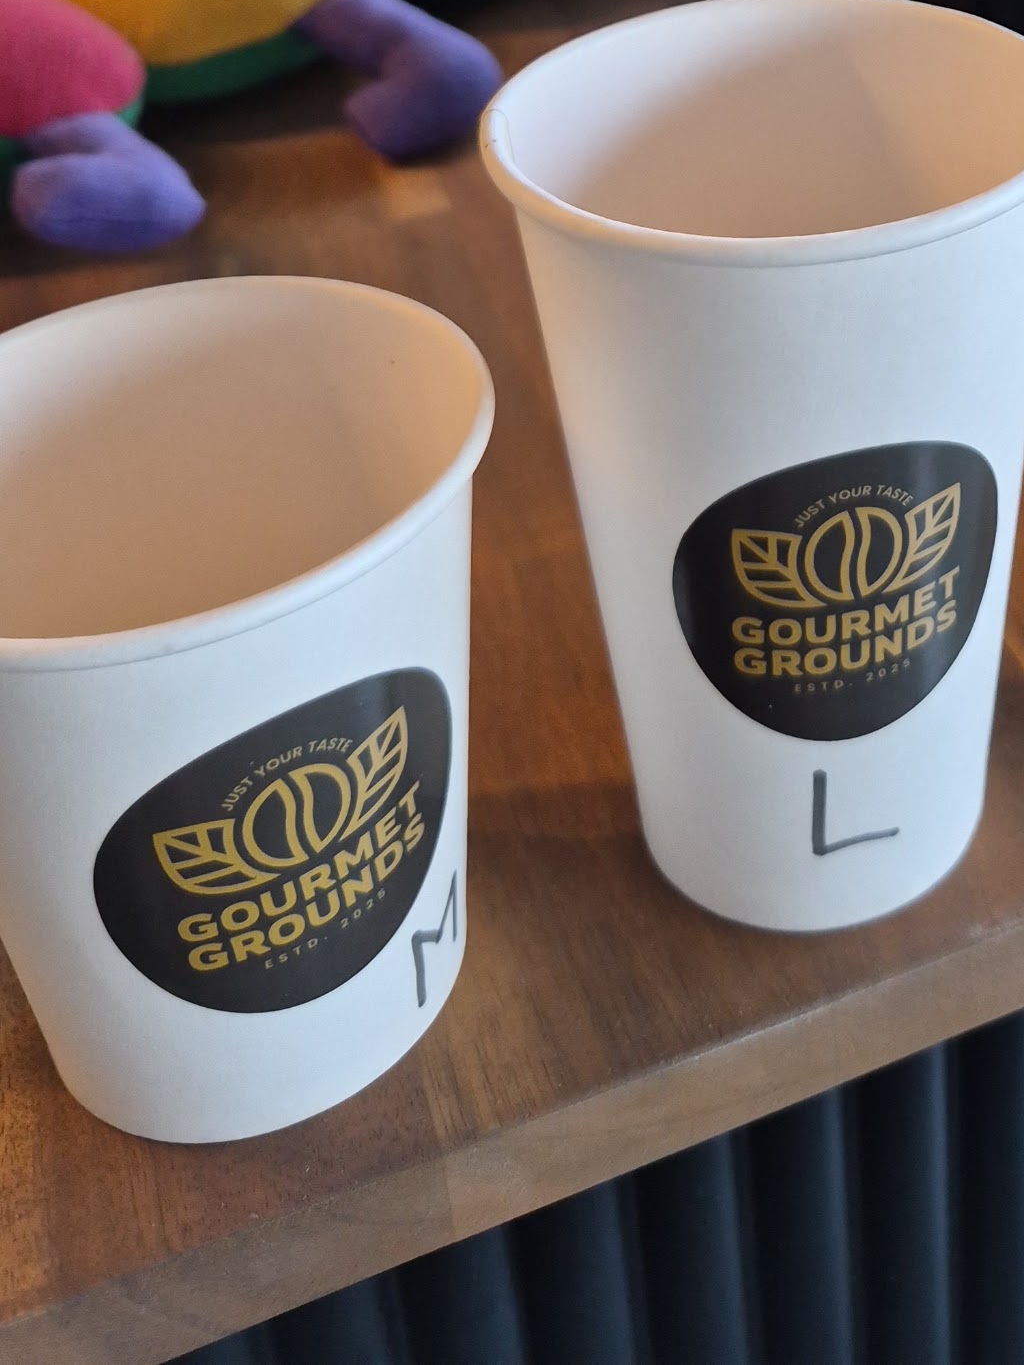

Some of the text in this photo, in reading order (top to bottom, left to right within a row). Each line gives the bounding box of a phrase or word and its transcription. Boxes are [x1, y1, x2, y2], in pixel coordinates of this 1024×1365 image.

[796, 484, 915, 528] JUST YOUR TASTE
[732, 565, 960, 646] GOURMET
[733, 600, 957, 676] GROUNDS
[866, 658, 911, 682] 2025
[222, 737, 353, 811] JUST YOUR TASTE
[812, 769, 900, 856] L
[177, 780, 420, 942] GOURMET
[188, 813, 425, 971] GROUNDS
[340, 889, 385, 929] 2025
[411, 869, 458, 1009] M
